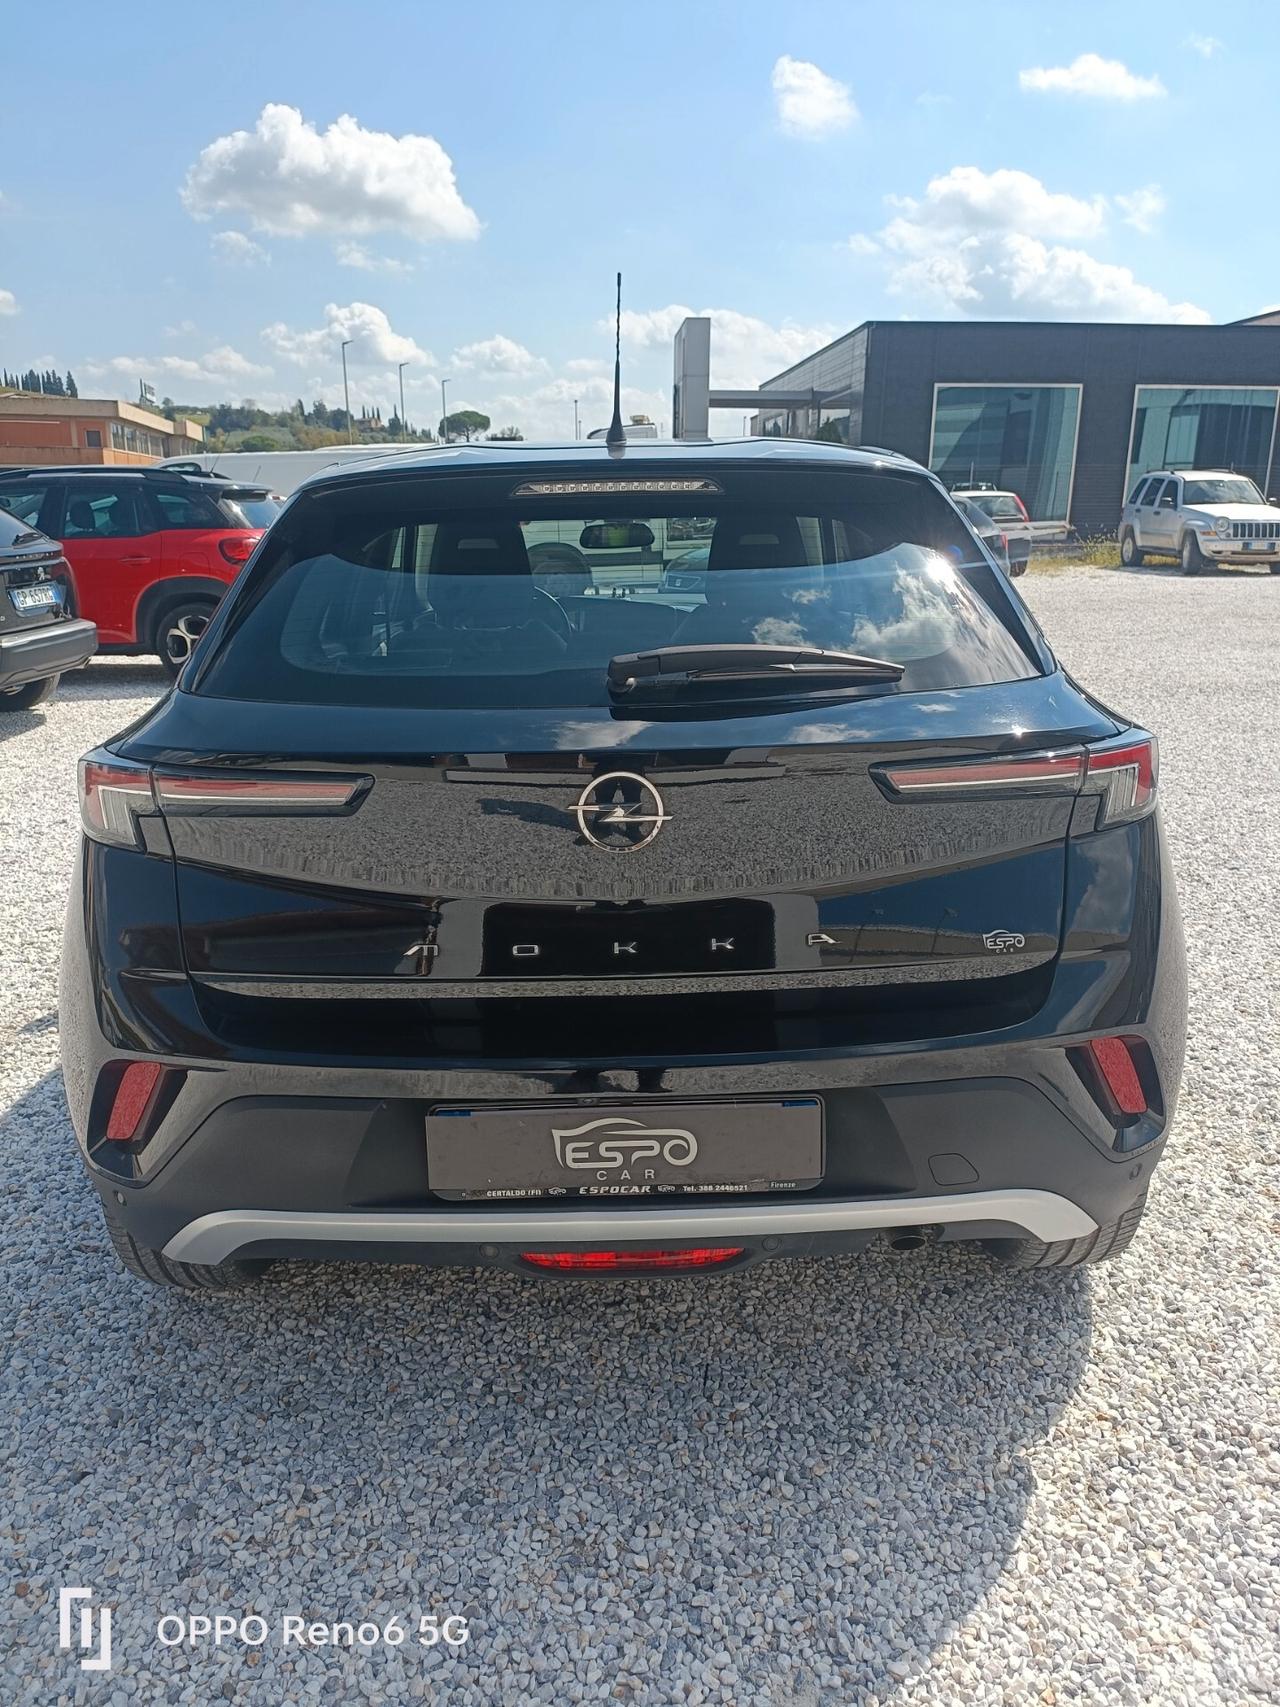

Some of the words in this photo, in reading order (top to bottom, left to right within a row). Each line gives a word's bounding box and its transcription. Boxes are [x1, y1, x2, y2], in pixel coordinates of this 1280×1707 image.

[984, 933, 1025, 949] ESPO
[557, 1128, 698, 1170] ESPO
[596, 1169, 655, 1181] CAR
[486, 1189, 526, 1197] CERTALDO
[579, 1185, 651, 1195] ESPOCAR
[770, 1181, 796, 1189] Firenze
